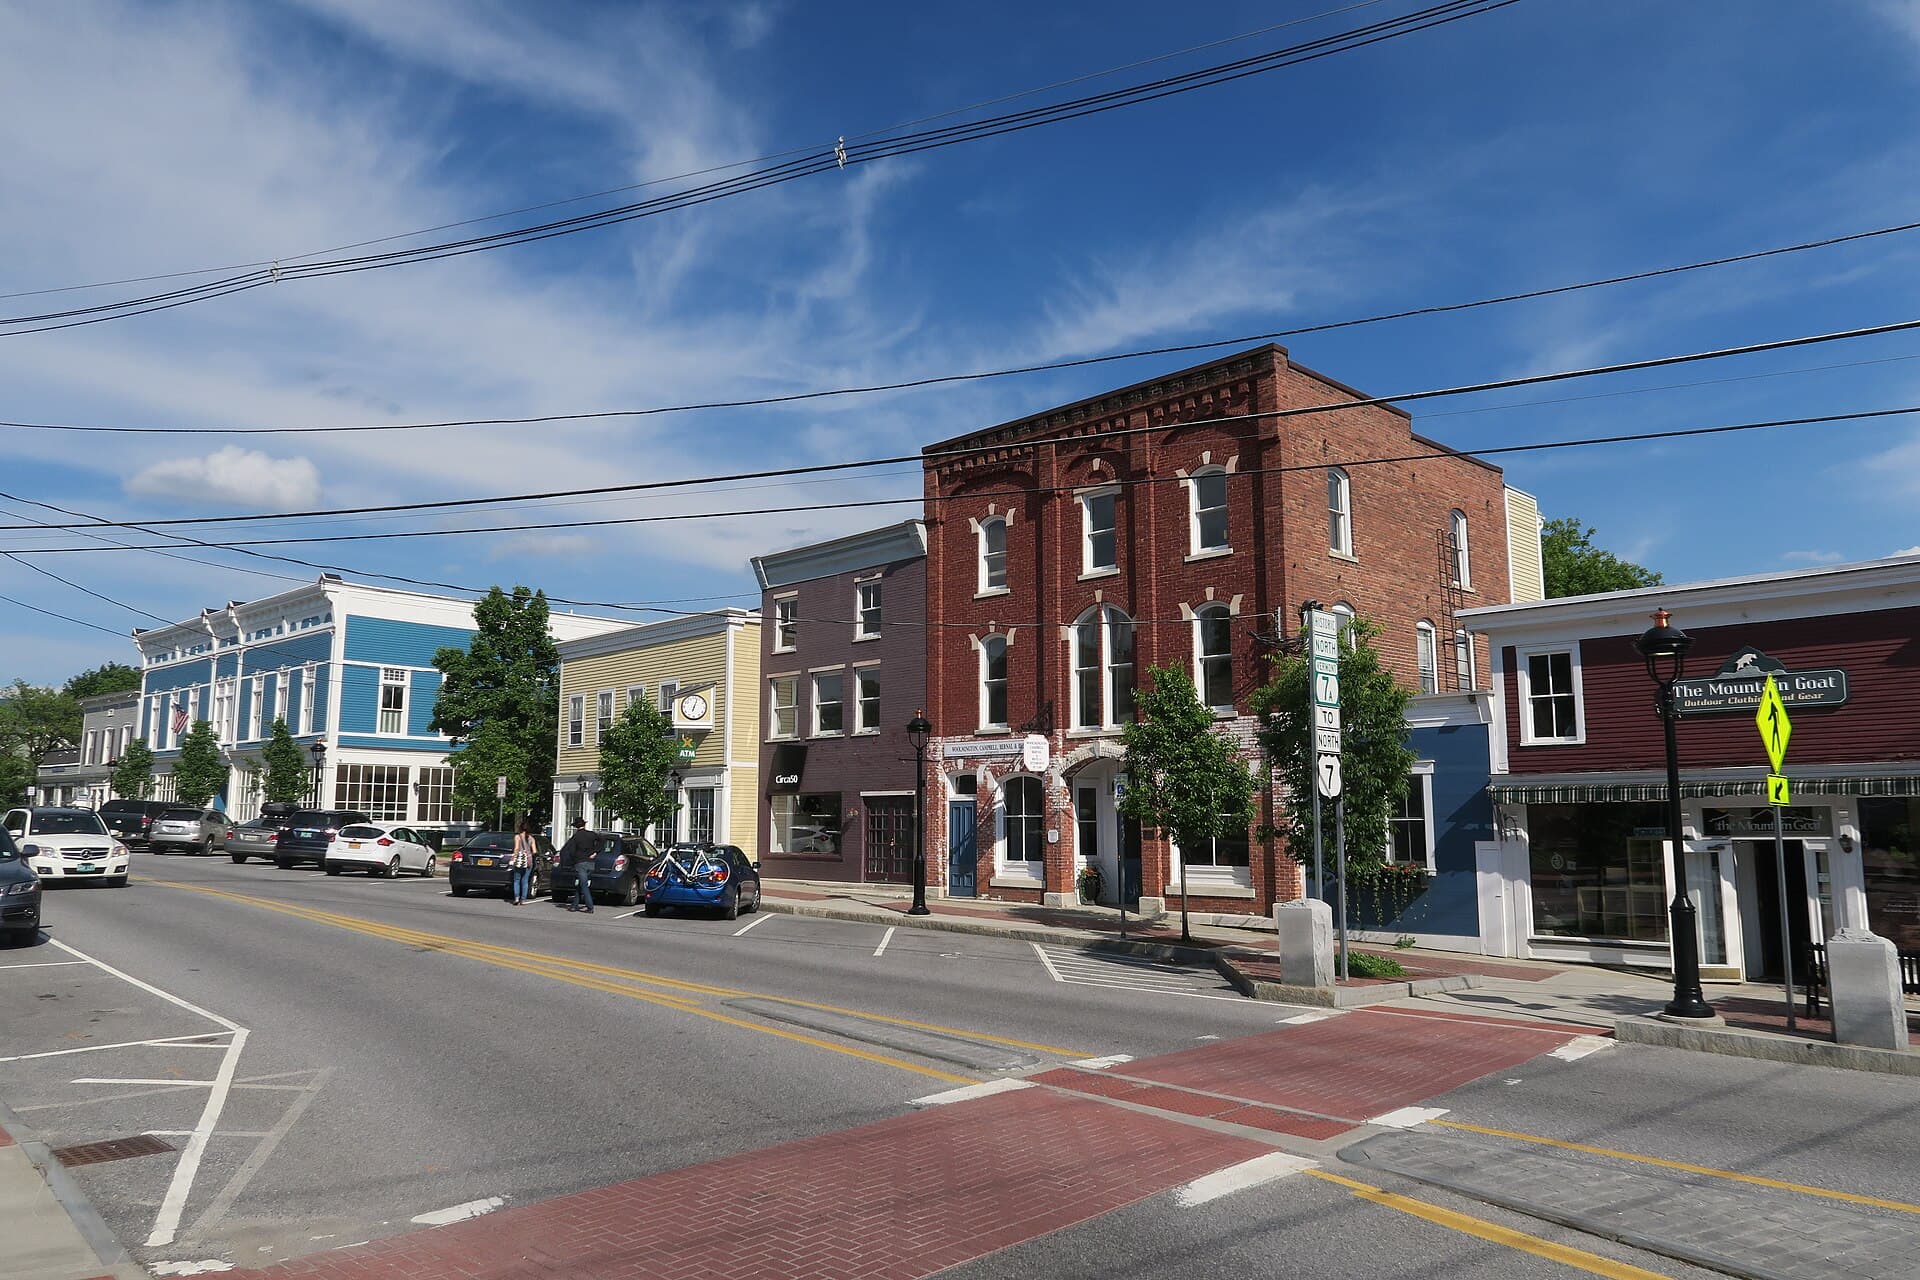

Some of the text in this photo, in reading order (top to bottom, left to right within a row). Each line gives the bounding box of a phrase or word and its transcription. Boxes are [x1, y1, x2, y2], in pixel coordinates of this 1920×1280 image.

[1315, 639, 1336, 655] NORTH
[1316, 662, 1337, 674] VERMONT
[1672, 684, 1703, 698] The
[1795, 676, 1837, 690] Goat
[1684, 698, 1725, 707] Outdoor
[1782, 693, 1794, 701] nd
[1798, 692, 1825, 700] Gear
[1322, 711, 1334, 725] TO
[1318, 734, 1339, 748] NORTH
[680, 750, 696, 758] ATM
[775, 774, 798, 784] Circa50
[1325, 765, 1334, 790] 7
